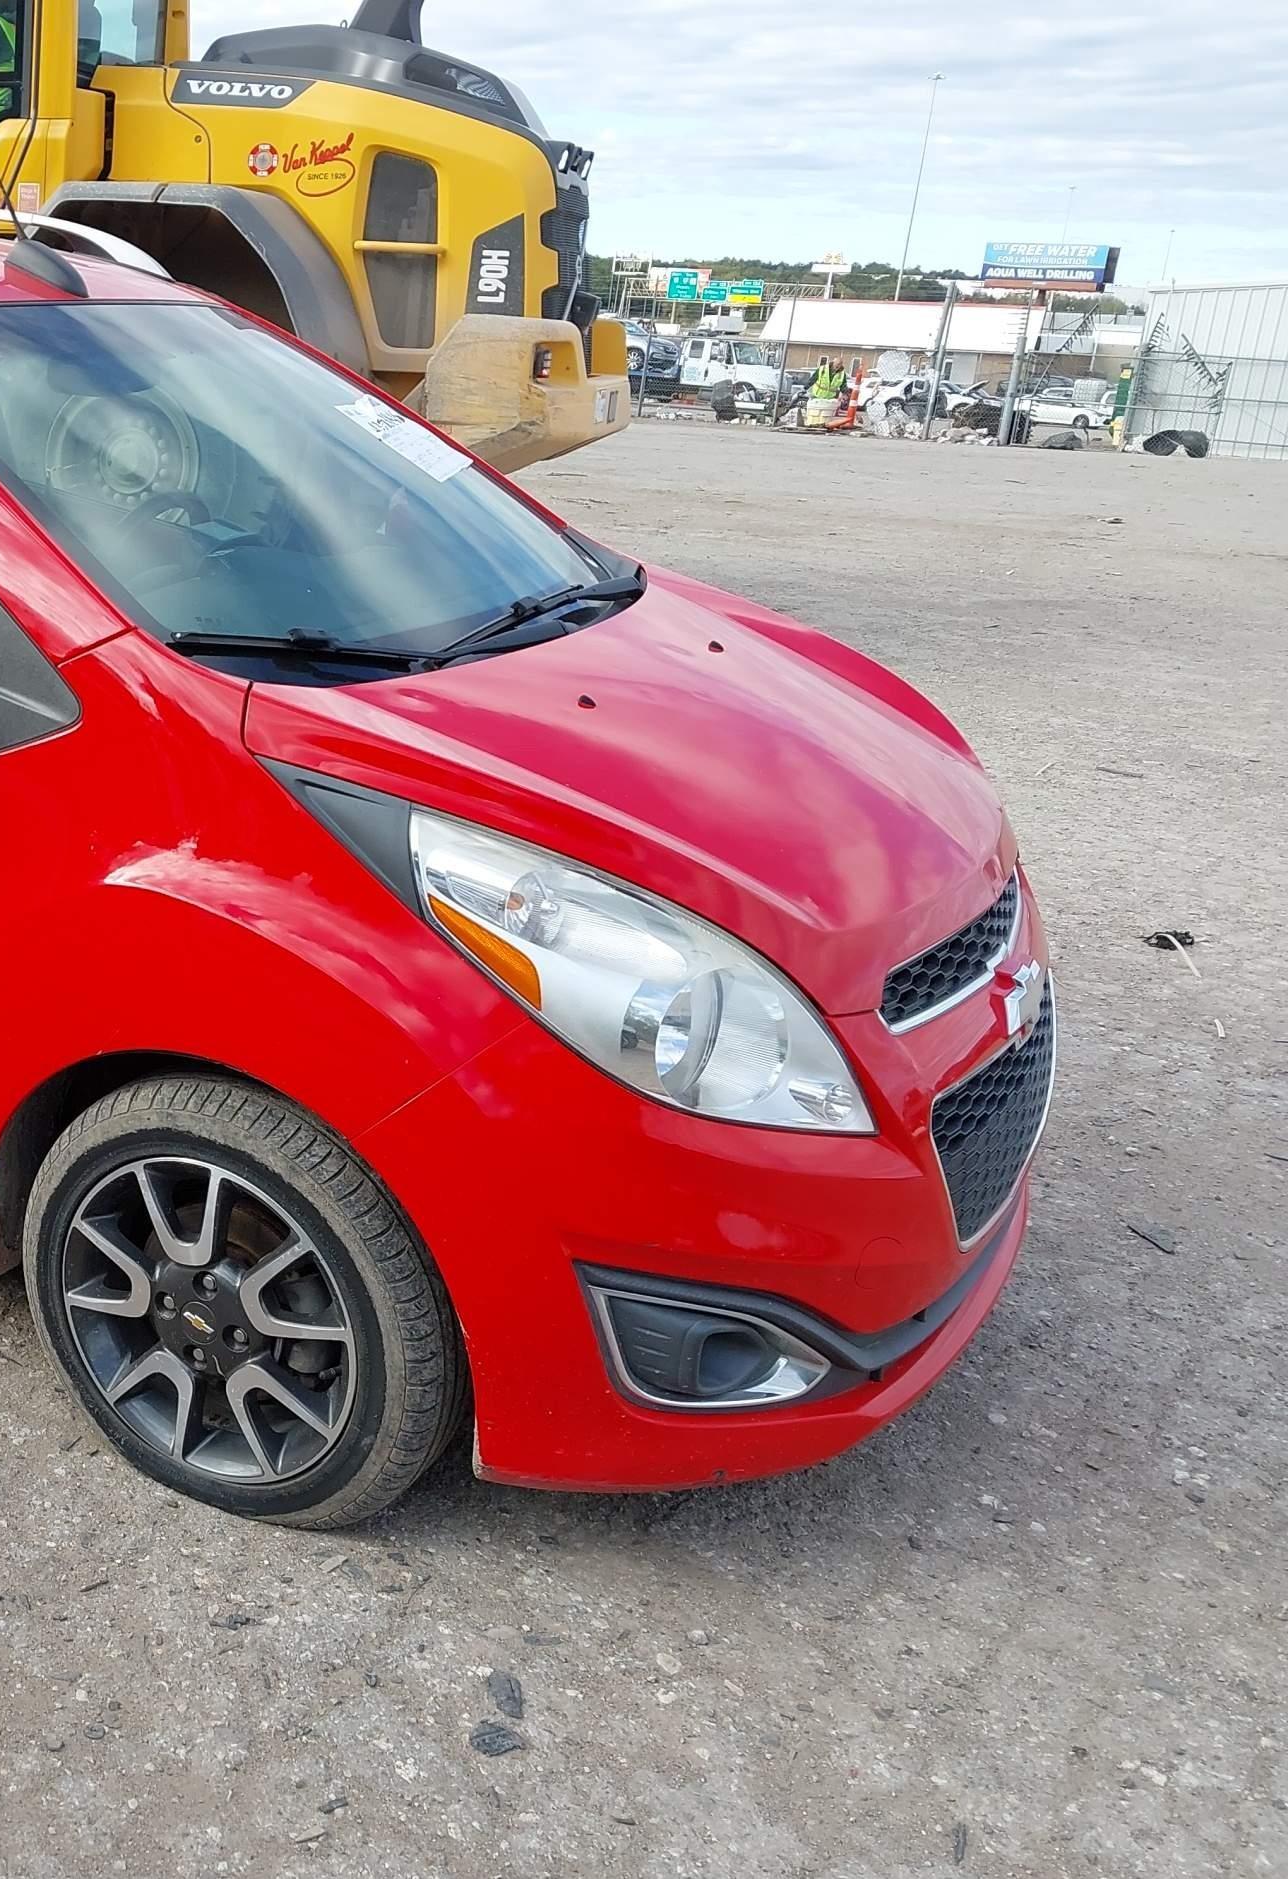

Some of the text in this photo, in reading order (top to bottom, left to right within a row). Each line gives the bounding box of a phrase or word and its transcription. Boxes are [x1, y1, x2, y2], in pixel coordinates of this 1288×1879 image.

[186, 79, 293, 99] VOLVO
[282, 143, 307, 173] Van
[307, 172, 329, 180] SINCE
[1008, 244, 1046, 256] FREE
[1047, 245, 1098, 257] WATER
[997, 255, 1088, 265] FOR LAWN IRRIGATION
[476, 249, 511, 303] L90H
[985, 267, 1095, 280] AQUA WELL DRILLING
